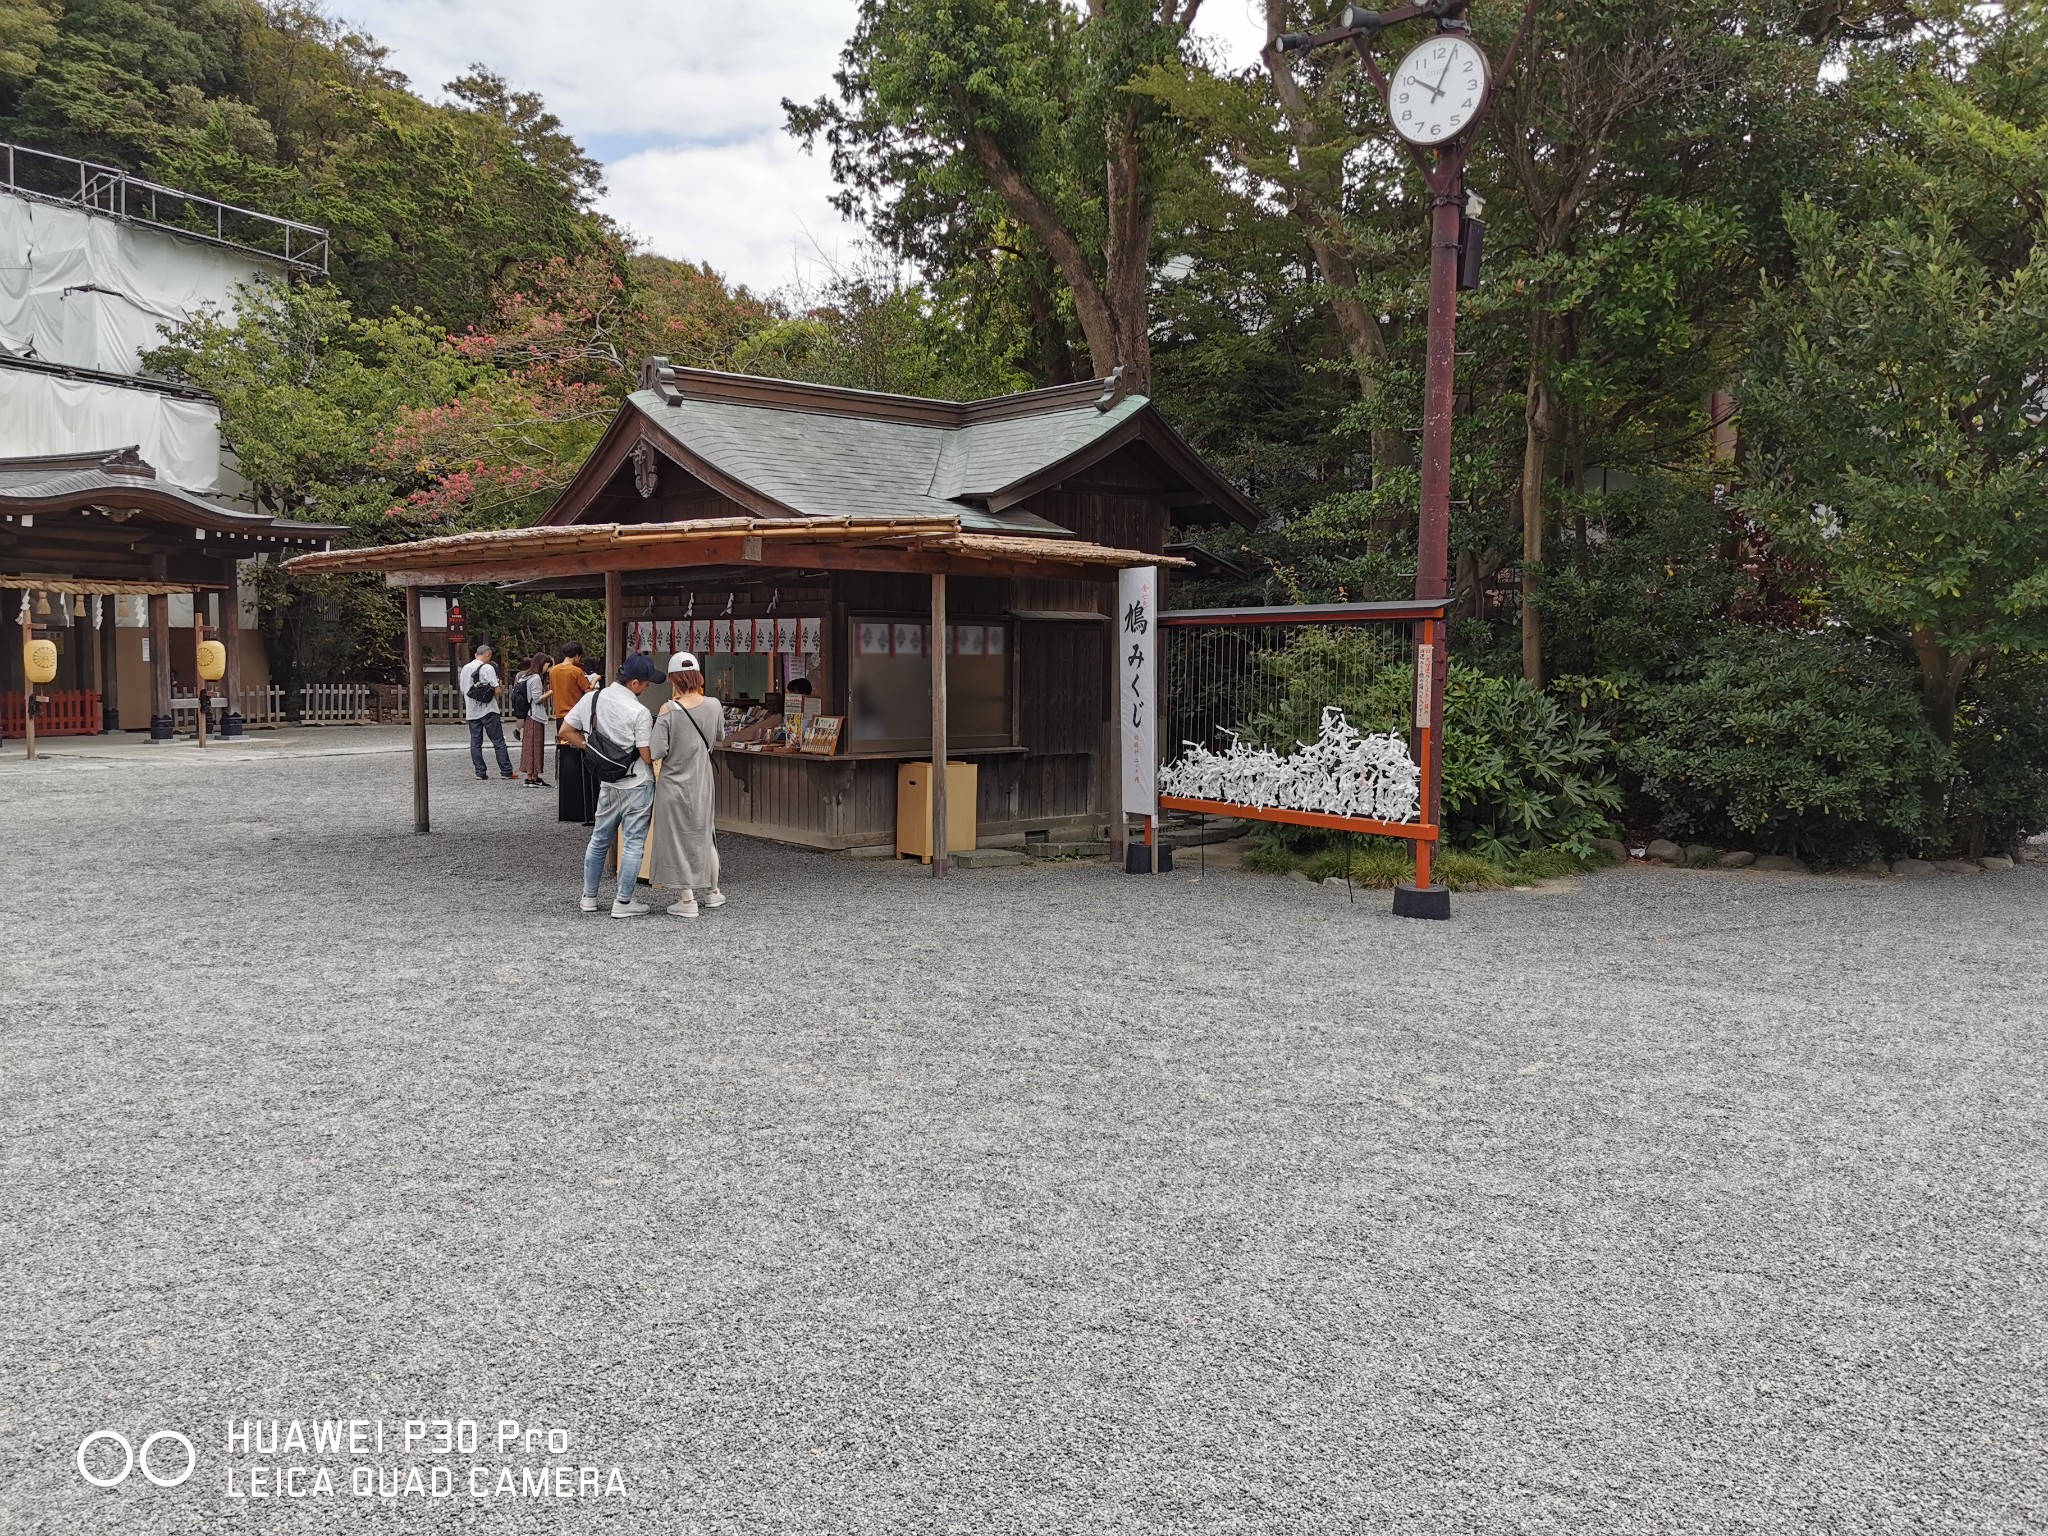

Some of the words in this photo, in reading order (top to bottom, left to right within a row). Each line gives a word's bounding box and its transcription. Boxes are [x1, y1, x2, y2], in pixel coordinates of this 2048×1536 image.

[1433, 47, 1446, 60] 12
[1415, 58, 1427, 70] 11
[1463, 60, 1473, 72] 2
[1403, 75, 1415, 87] 10
[1467, 79, 1477, 90] 3
[1399, 92, 1409, 103] 9
[1461, 98, 1473, 109] 4
[1402, 110, 1412, 121] 8
[1450, 115, 1460, 126] 5
[1415, 122, 1425, 133] 7
[1430, 124, 1441, 135] 6
[1124, 600, 1148, 728] 鳩みくじ
